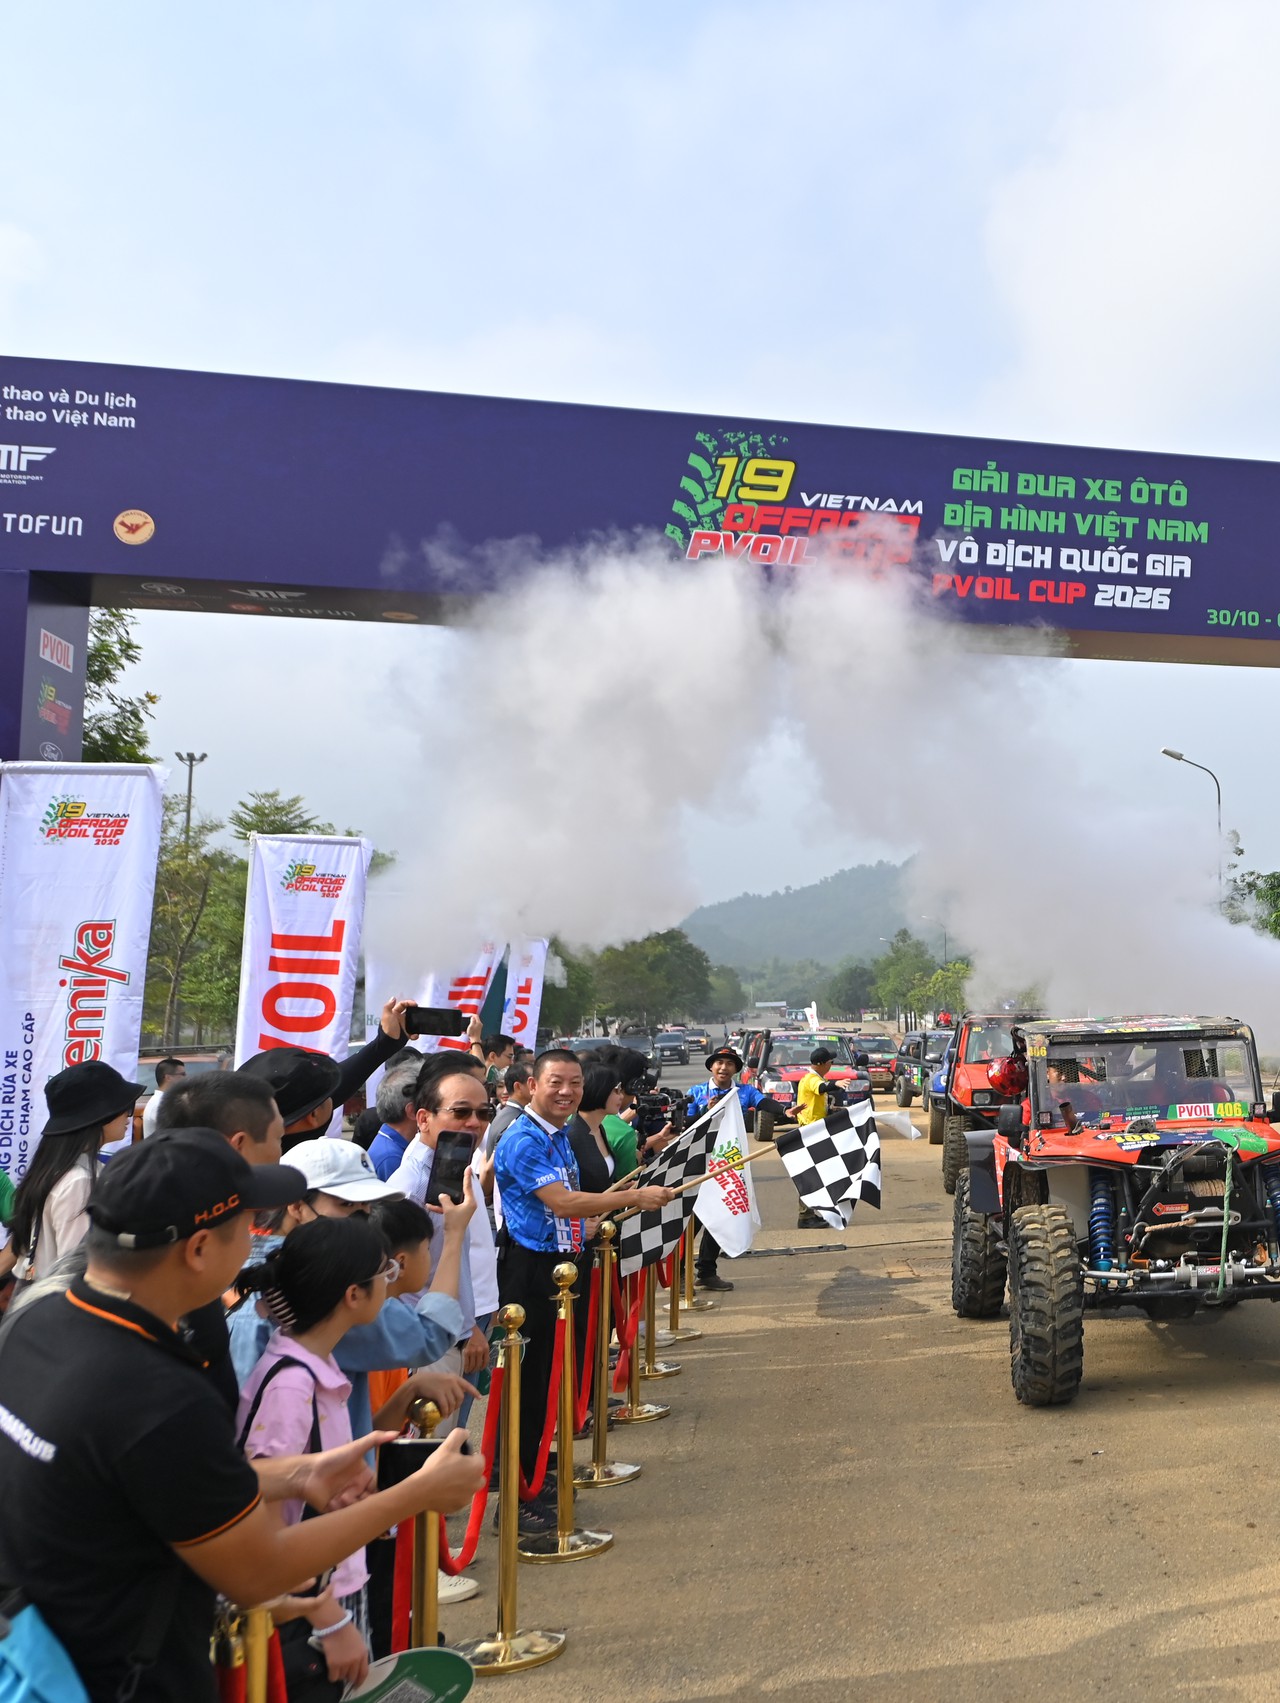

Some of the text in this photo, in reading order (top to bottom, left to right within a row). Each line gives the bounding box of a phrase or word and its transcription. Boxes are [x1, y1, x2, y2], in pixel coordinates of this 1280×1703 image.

[3, 385, 137, 410] thao và Du lịch
[5, 406, 136, 428] thao Việt Nam
[0, 444, 57, 471] MF
[716, 456, 796, 502] 19
[952, 461, 1188, 507] GIẢI ĐUA XE ÔTÔ
[800, 492, 923, 514] VIETNAM
[3, 513, 83, 536] TOFUN
[944, 499, 1209, 543] ĐỊA HÌNH VIỆT NAM
[686, 530, 817, 566] PVOIL
[936, 536, 1192, 578] VÔ ĐỊCH QUỐC GIA
[932, 574, 1172, 610] PVOIL CUP 2026
[1207, 609, 1260, 627] 30/10
[42, 631, 71, 670] PVOIL
[56, 802, 87, 818] 19
[46, 828, 124, 838] PVOIL CUP
[58, 819, 128, 828] OFFROAD
[294, 864, 316, 876] 19
[286, 883, 318, 891] PVOIL
[59, 919, 130, 1068] emika
[258, 920, 345, 1056] OIL
[21, 1012, 35, 1044] CẤP
[5, 1050, 18, 1068] XE
[22, 1049, 33, 1084] CAO
[0, 1073, 17, 1104] RỬA
[19, 1089, 33, 1135] CHẠM
[1178, 1104, 1212, 1117] PVOIL
[1217, 1103, 1242, 1117] 406
[536, 1173, 556, 1186] 2026
[721, 1197, 739, 1216] 2026
[727, 1189, 747, 1213] CUP
